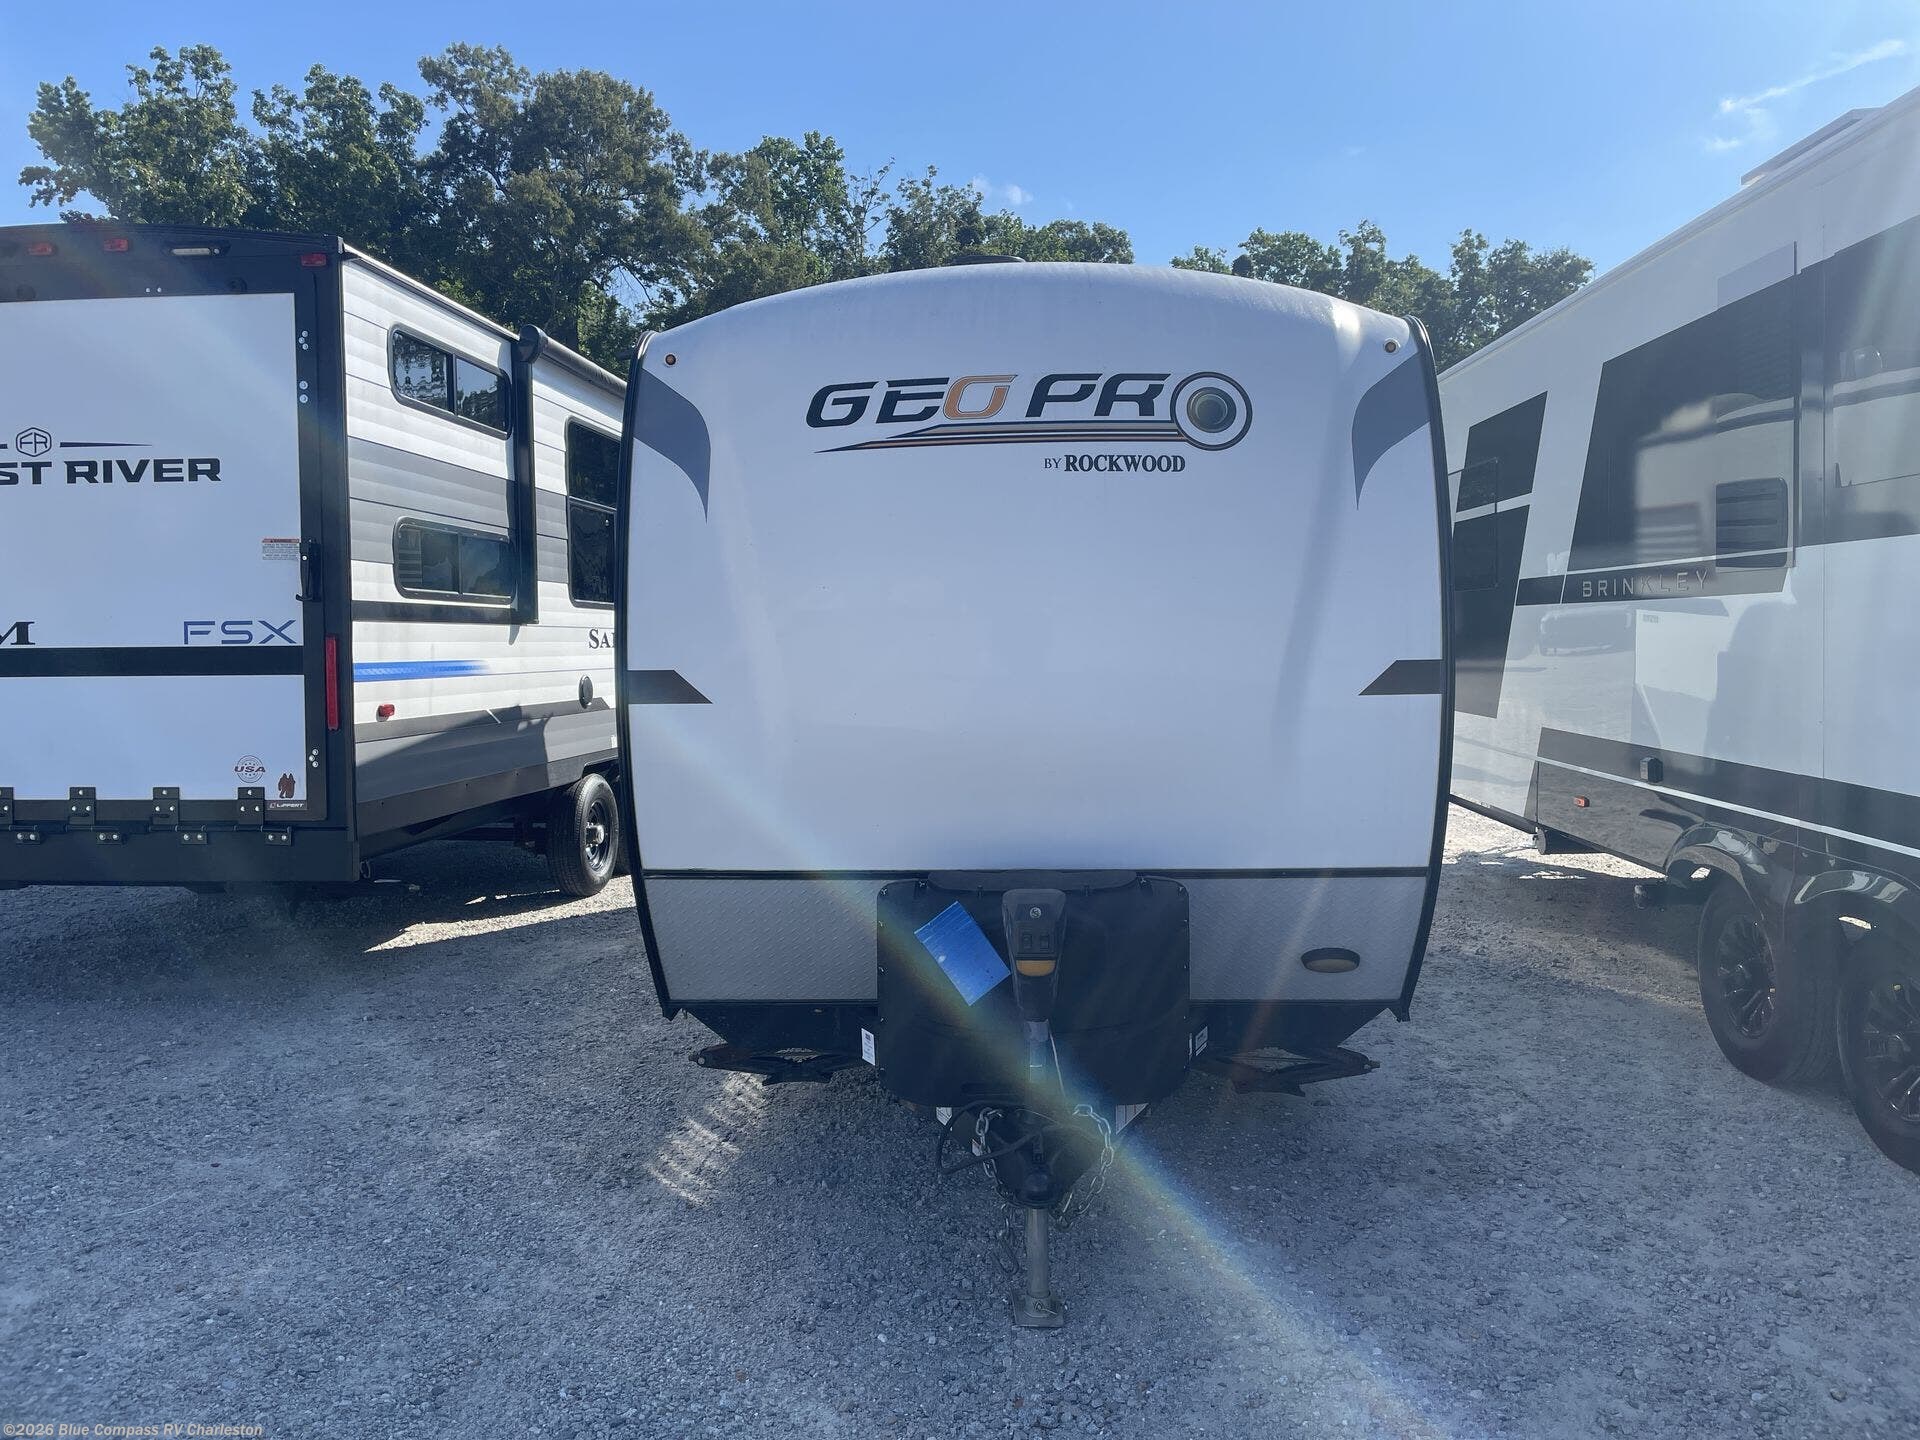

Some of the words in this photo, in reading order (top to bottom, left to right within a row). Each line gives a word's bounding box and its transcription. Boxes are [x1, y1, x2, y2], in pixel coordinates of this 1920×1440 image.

[805, 374, 1018, 428] GEO
[64, 458, 222, 485] RIVER
[1044, 458, 1062, 470] BY
[1065, 455, 1186, 473] ROCKWOOD
[1582, 569, 1709, 598] BRINKLEY
[183, 620, 297, 645] FSX
[588, 628, 616, 649] SA
[234, 765, 266, 773] USA
